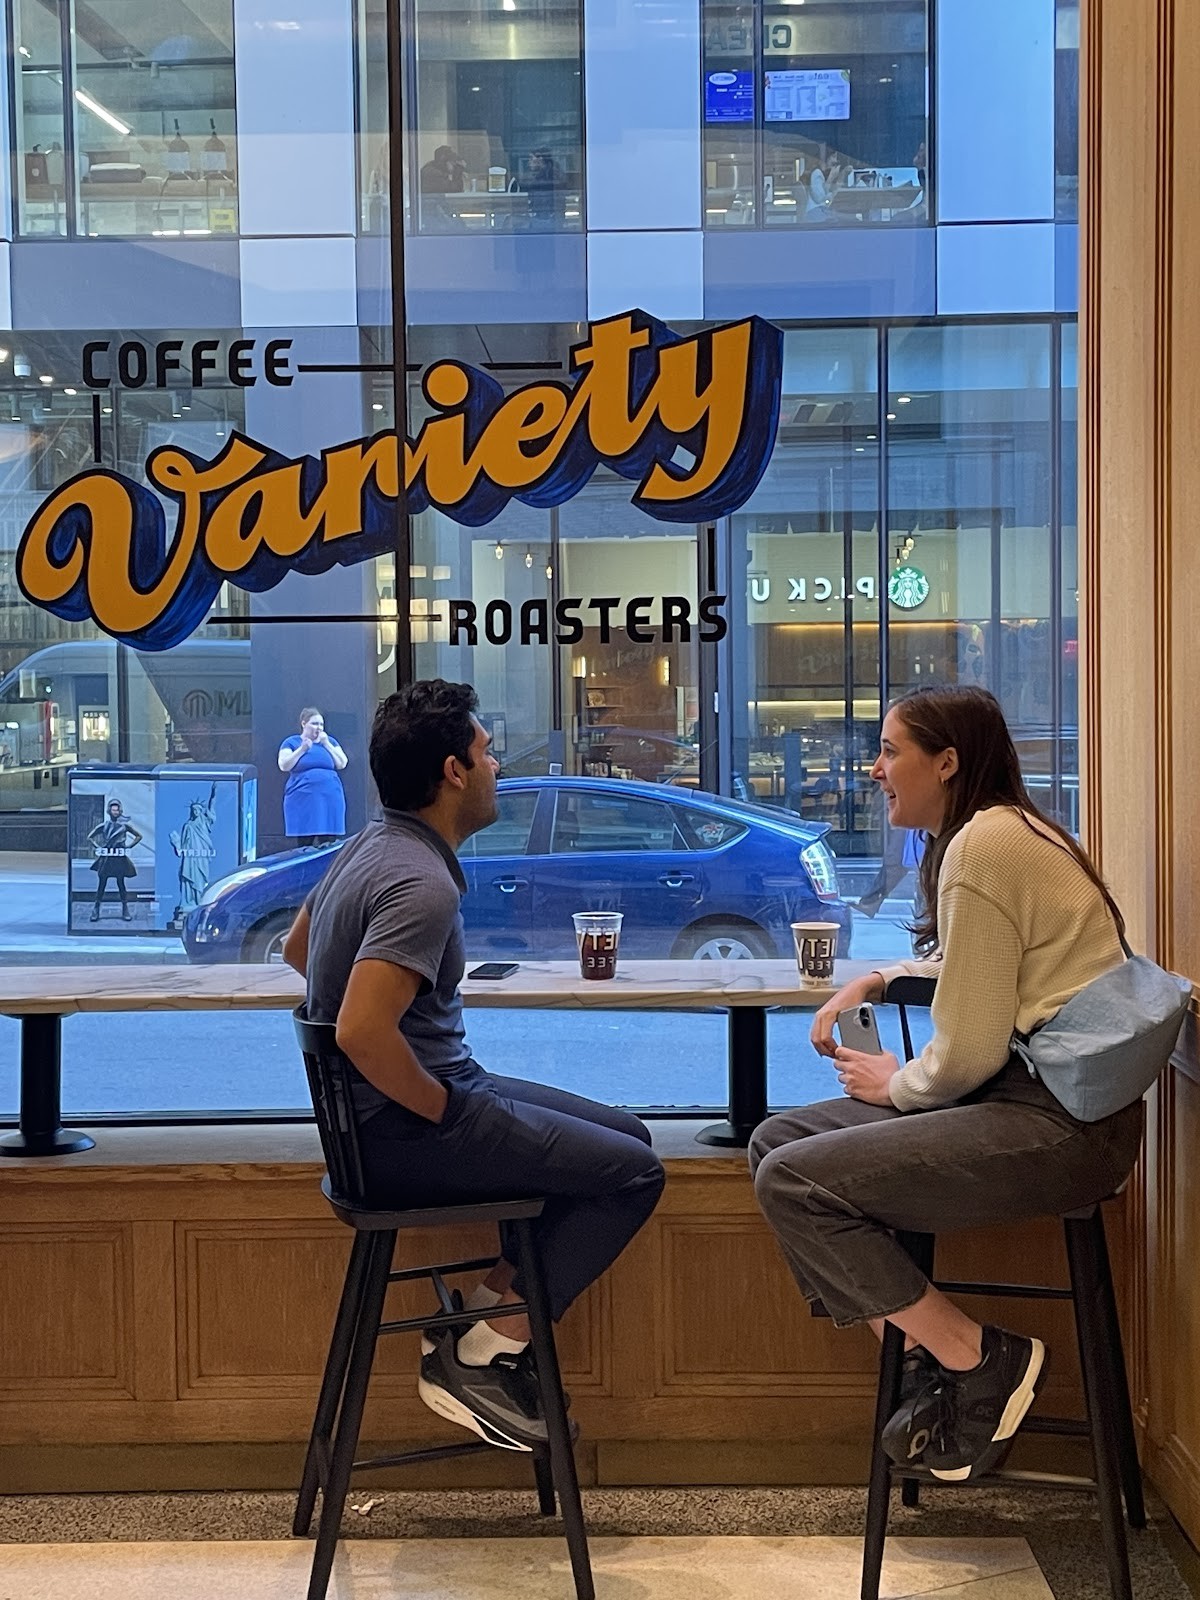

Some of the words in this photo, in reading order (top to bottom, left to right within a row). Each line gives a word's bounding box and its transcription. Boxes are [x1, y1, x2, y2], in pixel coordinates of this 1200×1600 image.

[83, 339, 293, 388] COFFEE
[17, 308, 783, 650] Variety
[449, 596, 727, 645] ROASTERS
